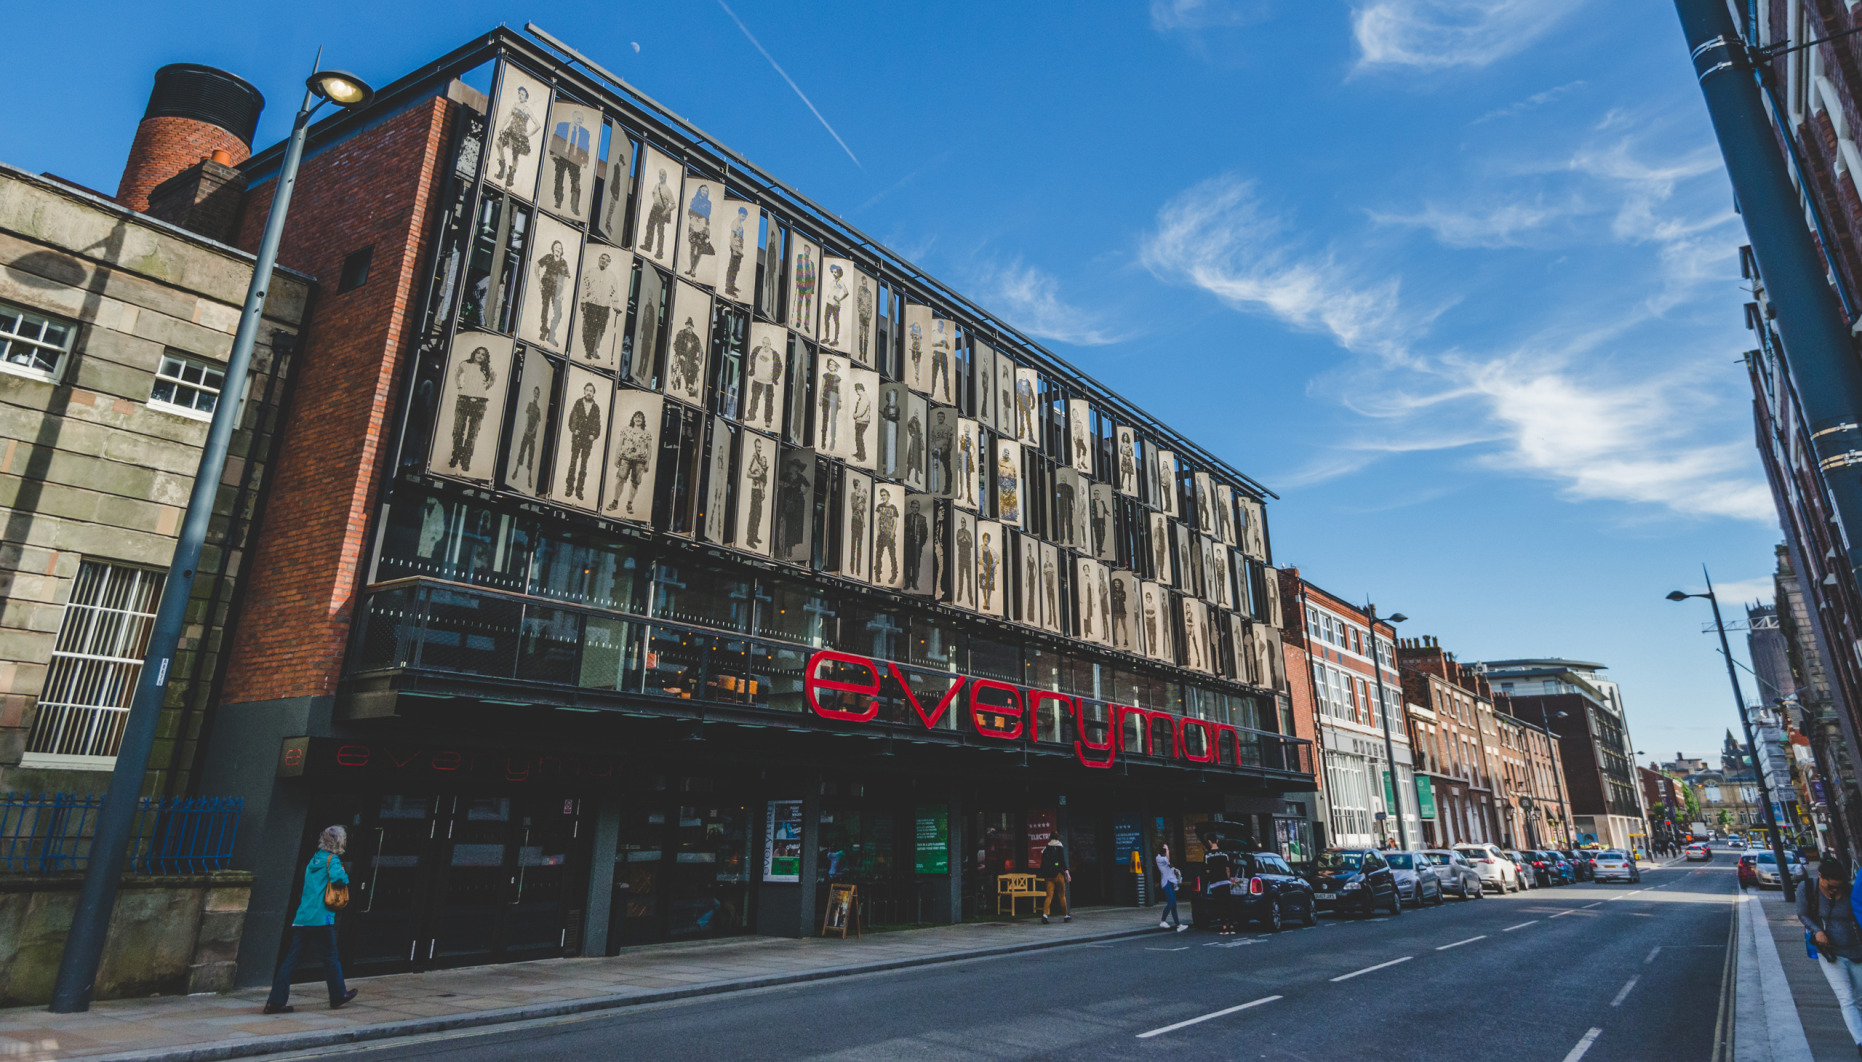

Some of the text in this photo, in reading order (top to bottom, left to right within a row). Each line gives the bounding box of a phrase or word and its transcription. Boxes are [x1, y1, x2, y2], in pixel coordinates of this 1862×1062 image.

[804, 650, 1242, 769] everyman
[336, 744, 640, 783] everyman
[763, 801, 774, 876] everyman
